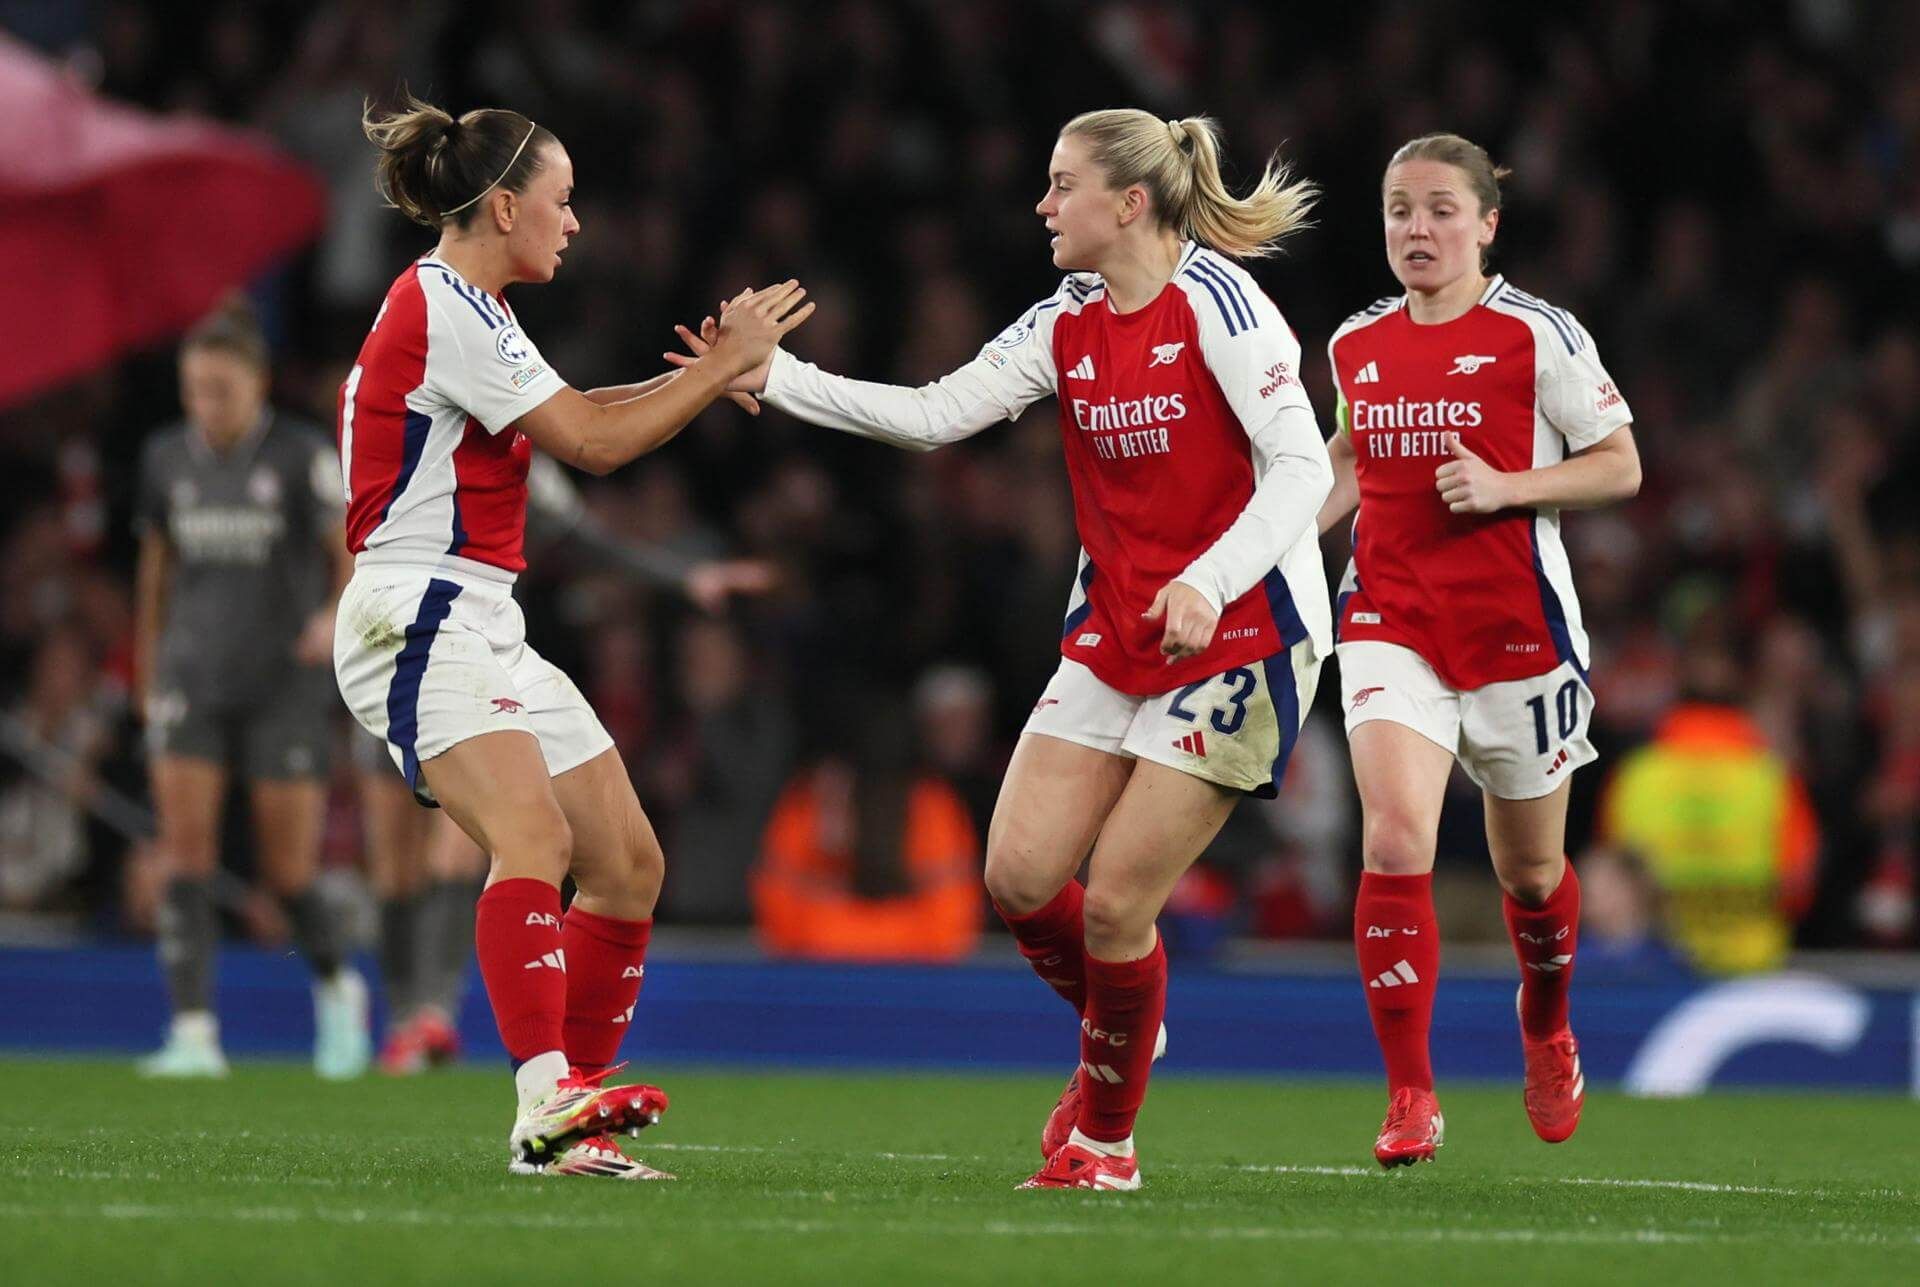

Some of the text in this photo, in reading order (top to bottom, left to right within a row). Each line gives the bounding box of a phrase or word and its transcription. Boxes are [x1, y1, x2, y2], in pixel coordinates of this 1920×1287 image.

[1264, 362, 1289, 379] VIS
[1073, 393, 1187, 431] Emirates
[1353, 396, 1483, 431] Emirates
[1093, 427, 1170, 459] FLY BETTER
[1369, 433, 1394, 458] FLY
[1166, 665, 1259, 736] 23
[1525, 678, 1580, 756] 10
[1081, 1018, 1128, 1047] AFC
